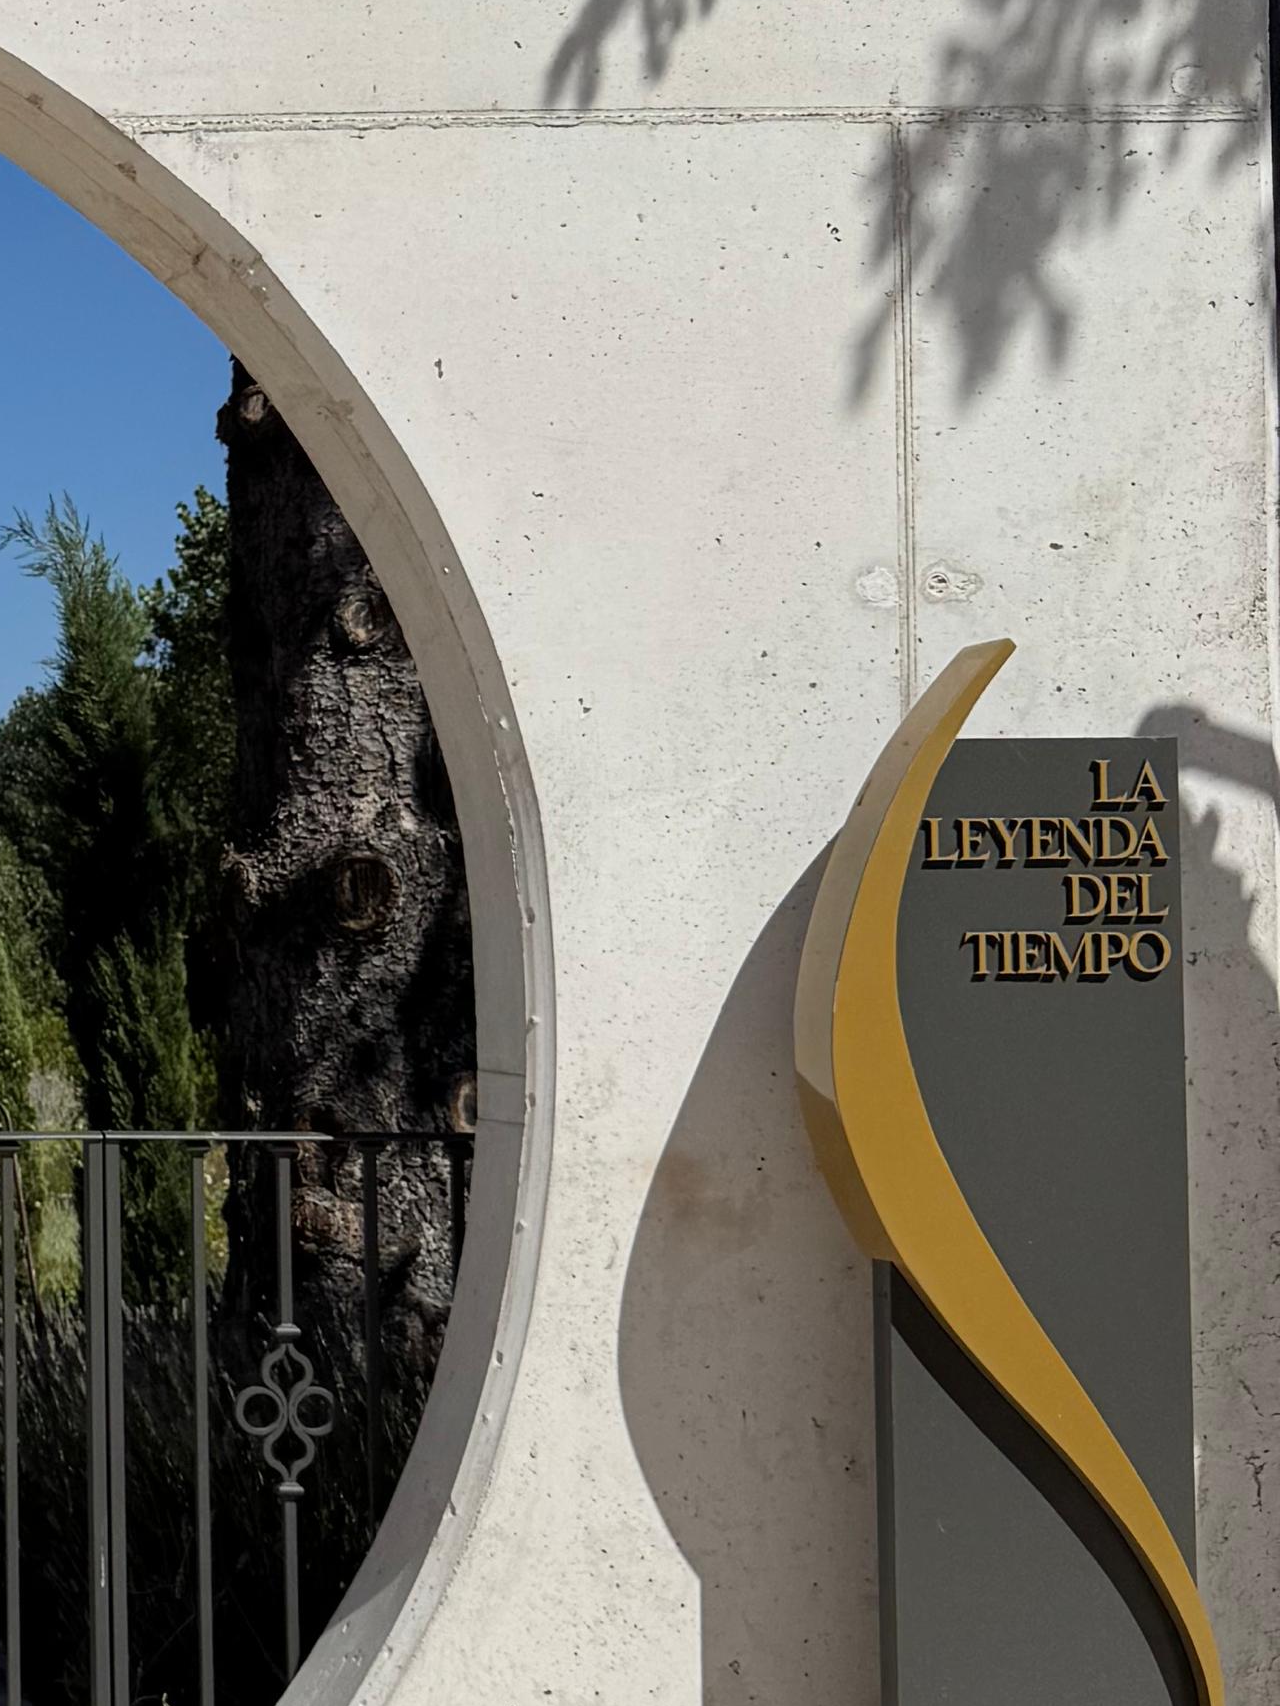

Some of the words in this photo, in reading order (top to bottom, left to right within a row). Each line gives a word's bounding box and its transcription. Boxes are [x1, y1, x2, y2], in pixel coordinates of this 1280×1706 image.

[1091, 759, 1170, 803] LA
[921, 816, 1170, 862] LEYENDA
[1063, 873, 1170, 917] DEL
[963, 930, 1172, 975] TIEMPO
